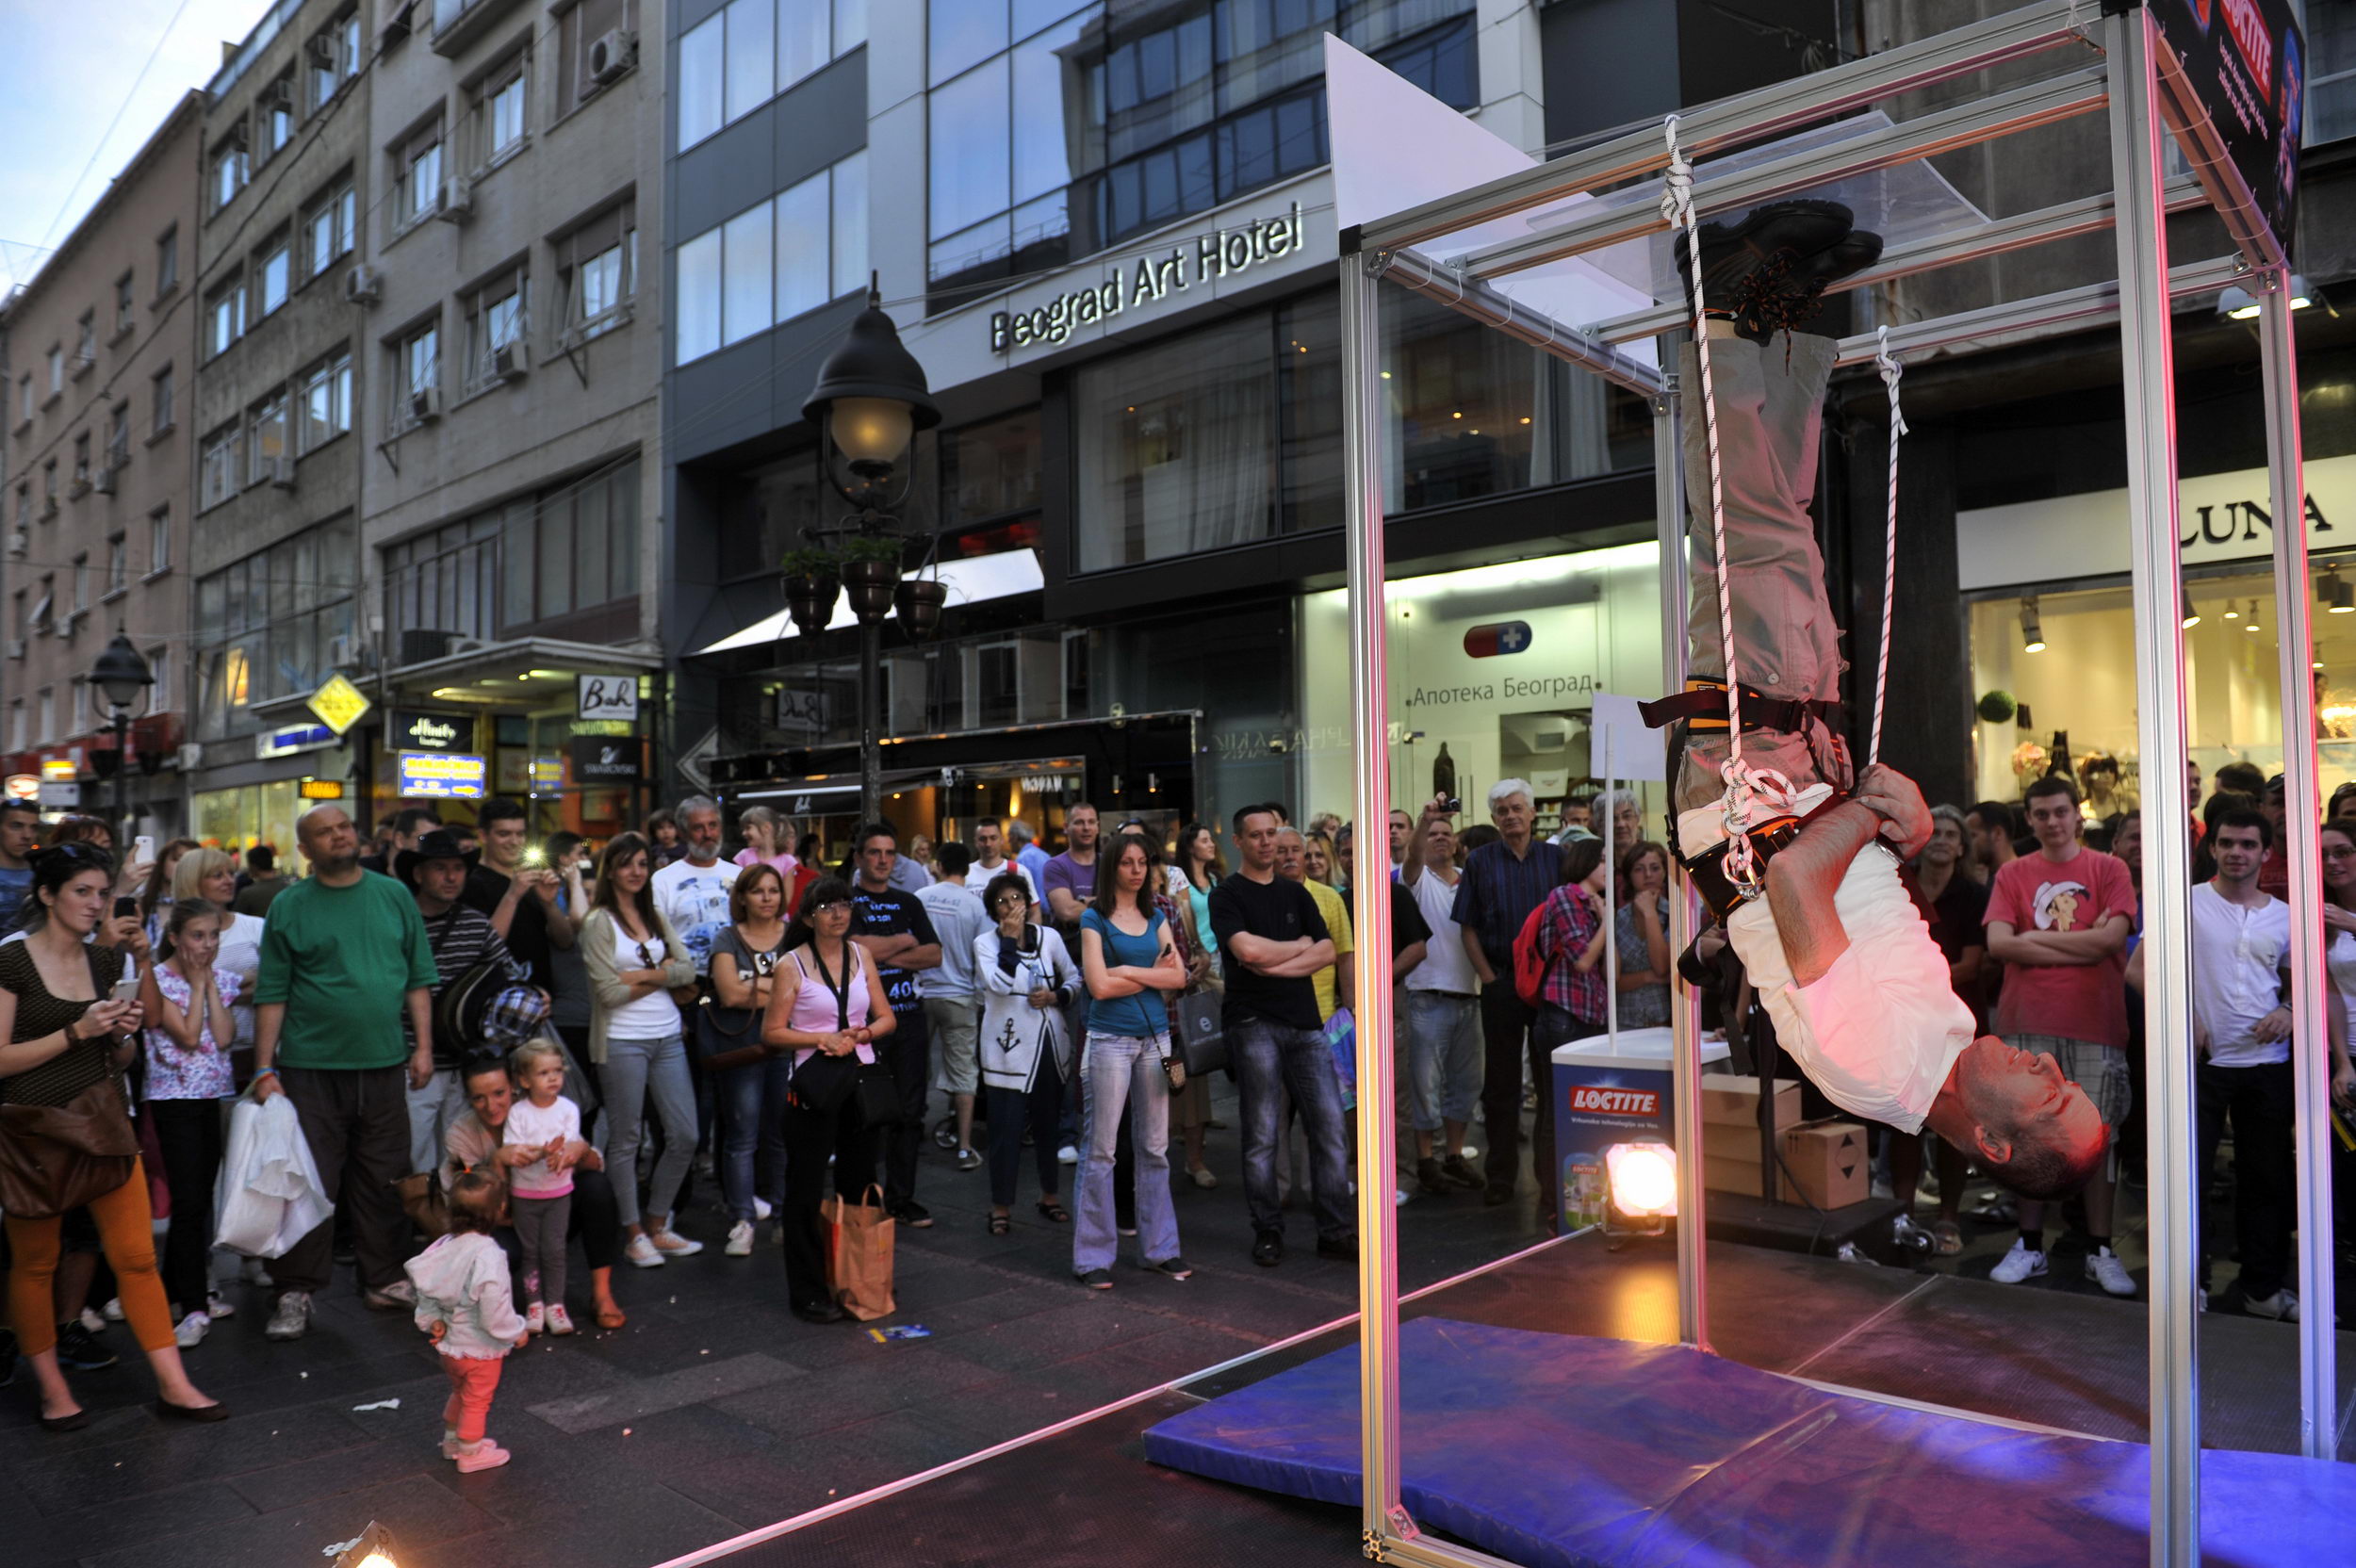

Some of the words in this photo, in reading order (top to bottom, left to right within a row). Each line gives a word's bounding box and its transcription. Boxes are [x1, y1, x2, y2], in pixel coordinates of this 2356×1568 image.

[2223, 0, 2271, 87] OCTITE
[990, 268, 1123, 356] Beograd
[1132, 247, 1189, 308] Art
[1197, 200, 1303, 282] Hotel
[1414, 684, 1494, 707] Апотека
[1504, 675, 1593, 698] Београд
[1574, 1090, 1655, 1112] LOCTITE
